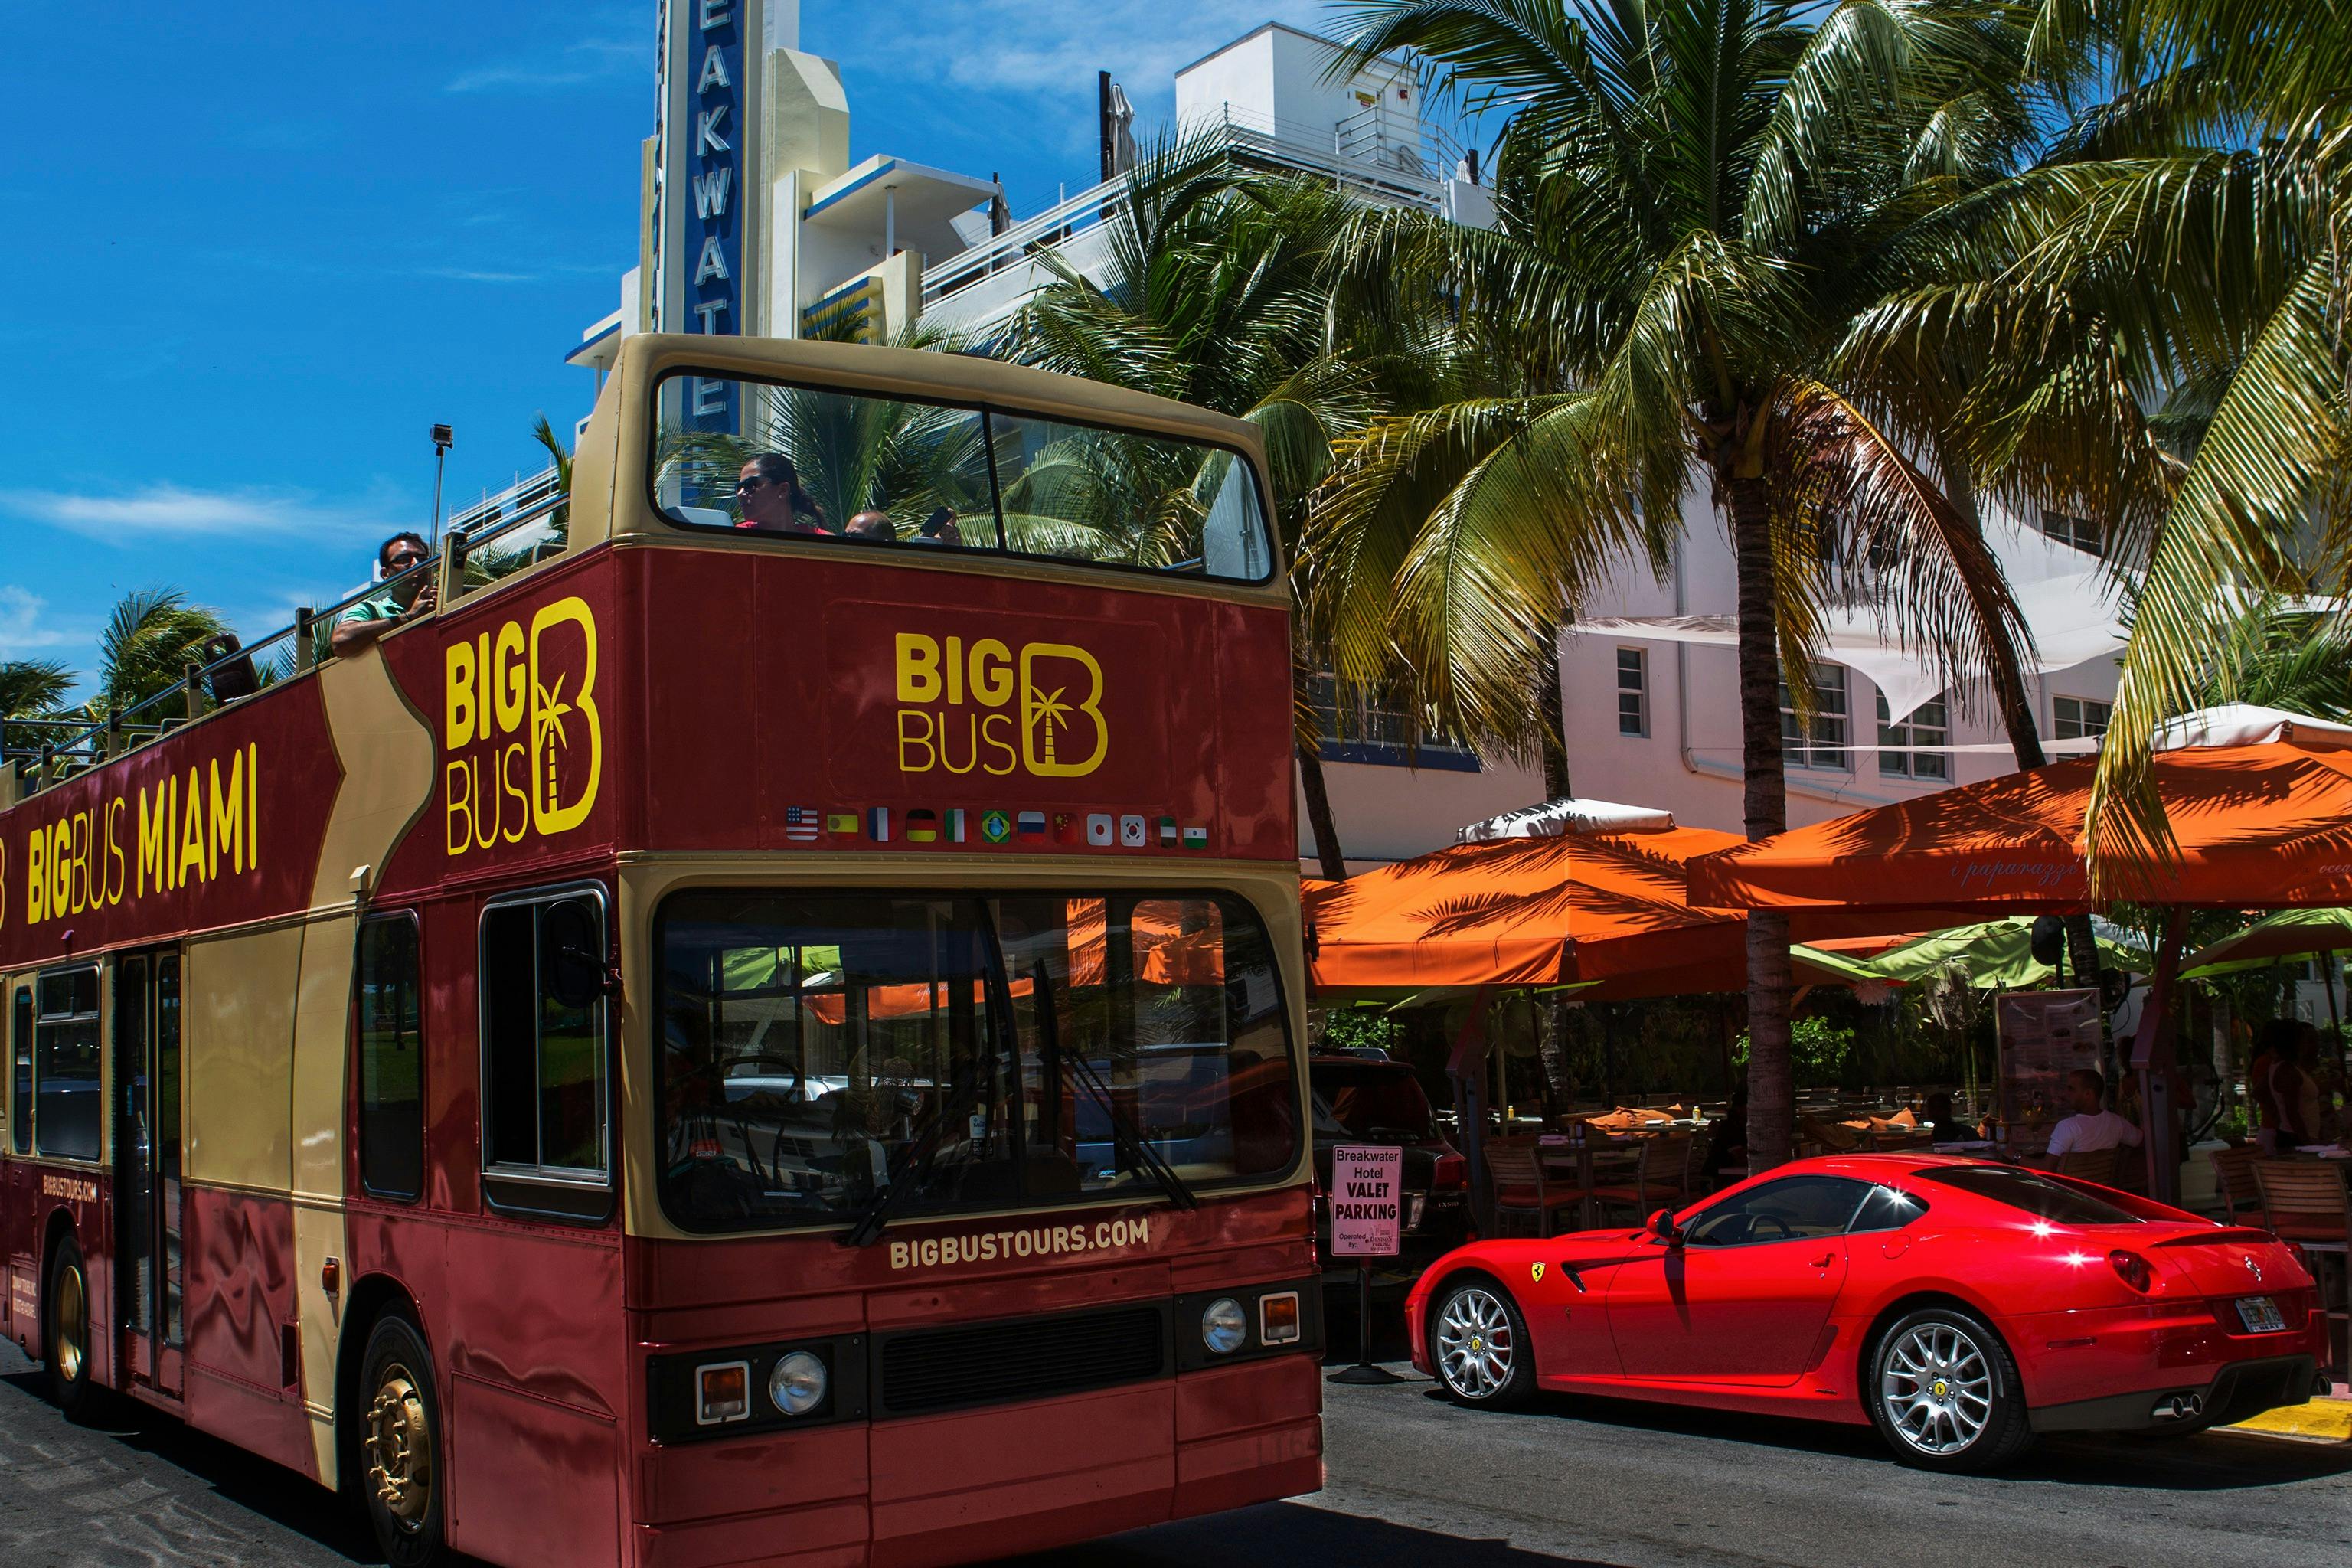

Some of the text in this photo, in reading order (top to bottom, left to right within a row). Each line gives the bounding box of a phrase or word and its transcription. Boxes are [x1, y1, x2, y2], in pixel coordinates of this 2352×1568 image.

[446, 621, 527, 750] BIG
[896, 633, 1014, 707] BIG
[897, 710, 1017, 776] BUS
[138, 741, 257, 898] MIAMI
[447, 743, 530, 856] BUS
[1337, 1150, 1399, 1162] Breakwater
[1354, 1167, 1383, 1178] Hotel
[44, 1174, 97, 1203] BIGBUSTOURS.COM
[1347, 1182, 1389, 1198] VALET
[1335, 1204, 1396, 1220] PARKING
[890, 1217, 1148, 1269] BIGBUSTOURS.COM
[1338, 1233, 1366, 1242] Operated
